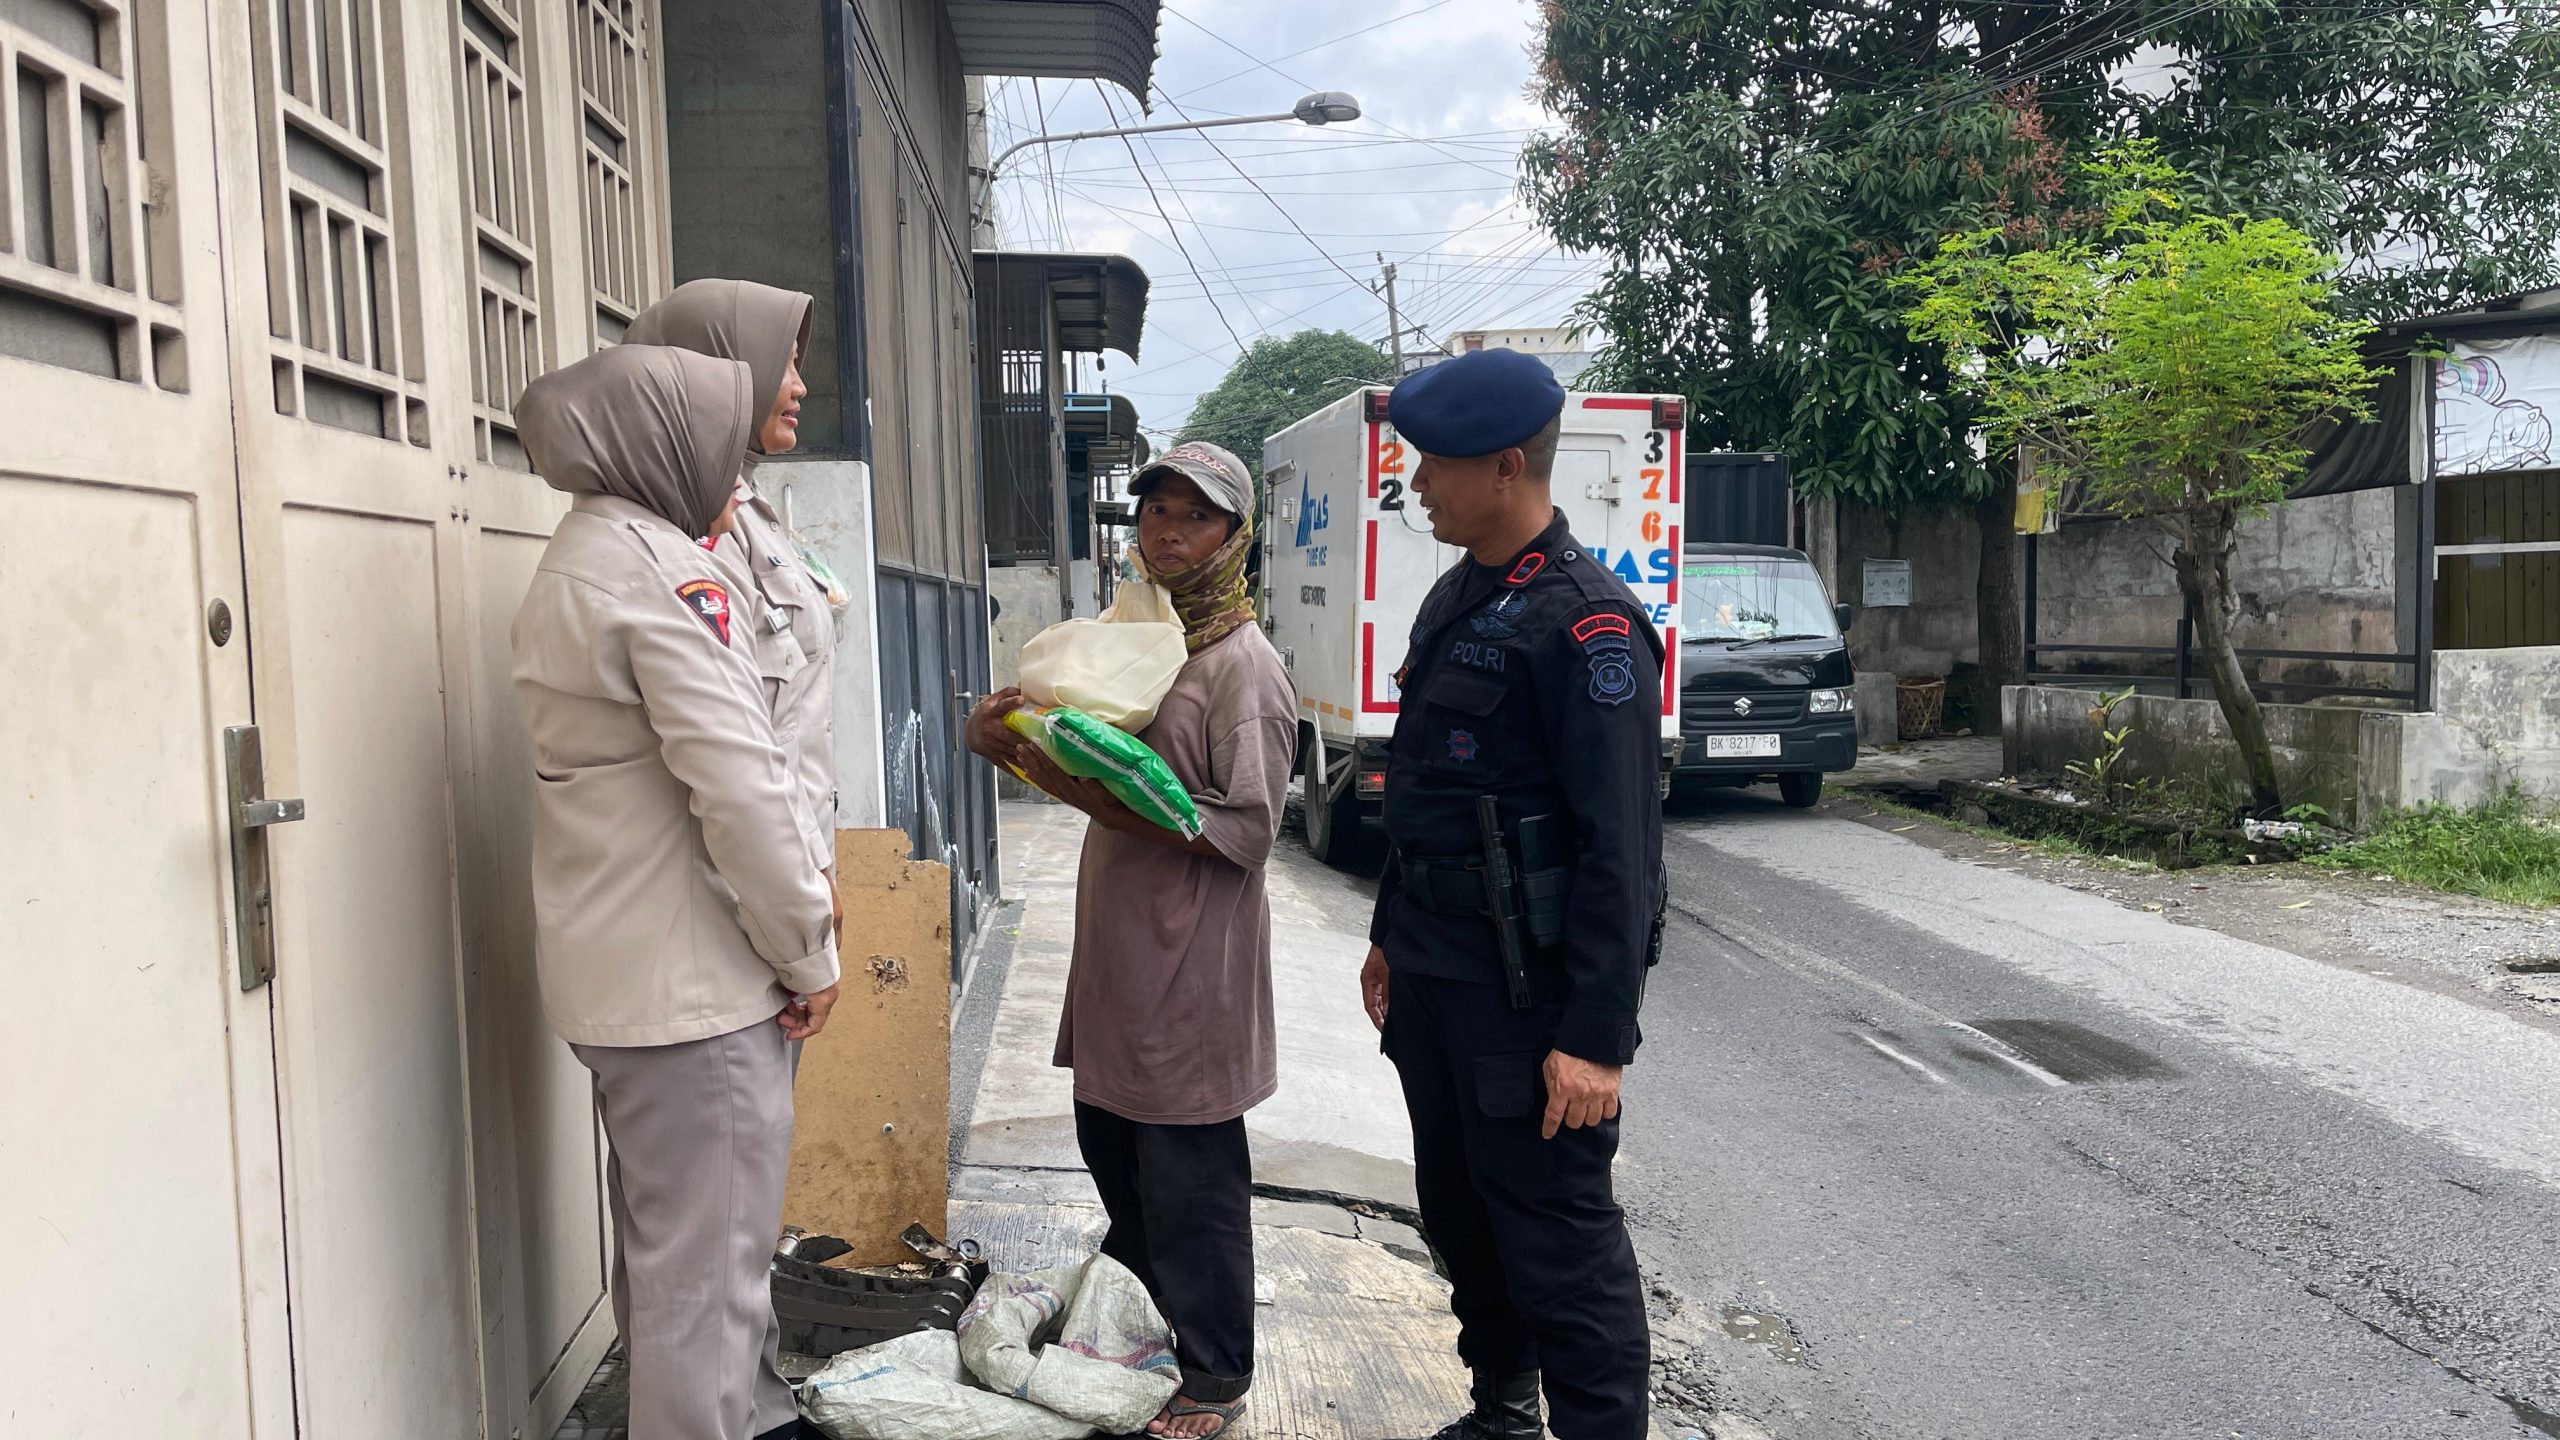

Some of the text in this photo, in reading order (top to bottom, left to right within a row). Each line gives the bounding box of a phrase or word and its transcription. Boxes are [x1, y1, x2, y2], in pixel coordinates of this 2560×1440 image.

[1450, 641, 1506, 673] POLRI
[1711, 737, 1723, 750] BK
[1729, 736, 1756, 750] 8217
